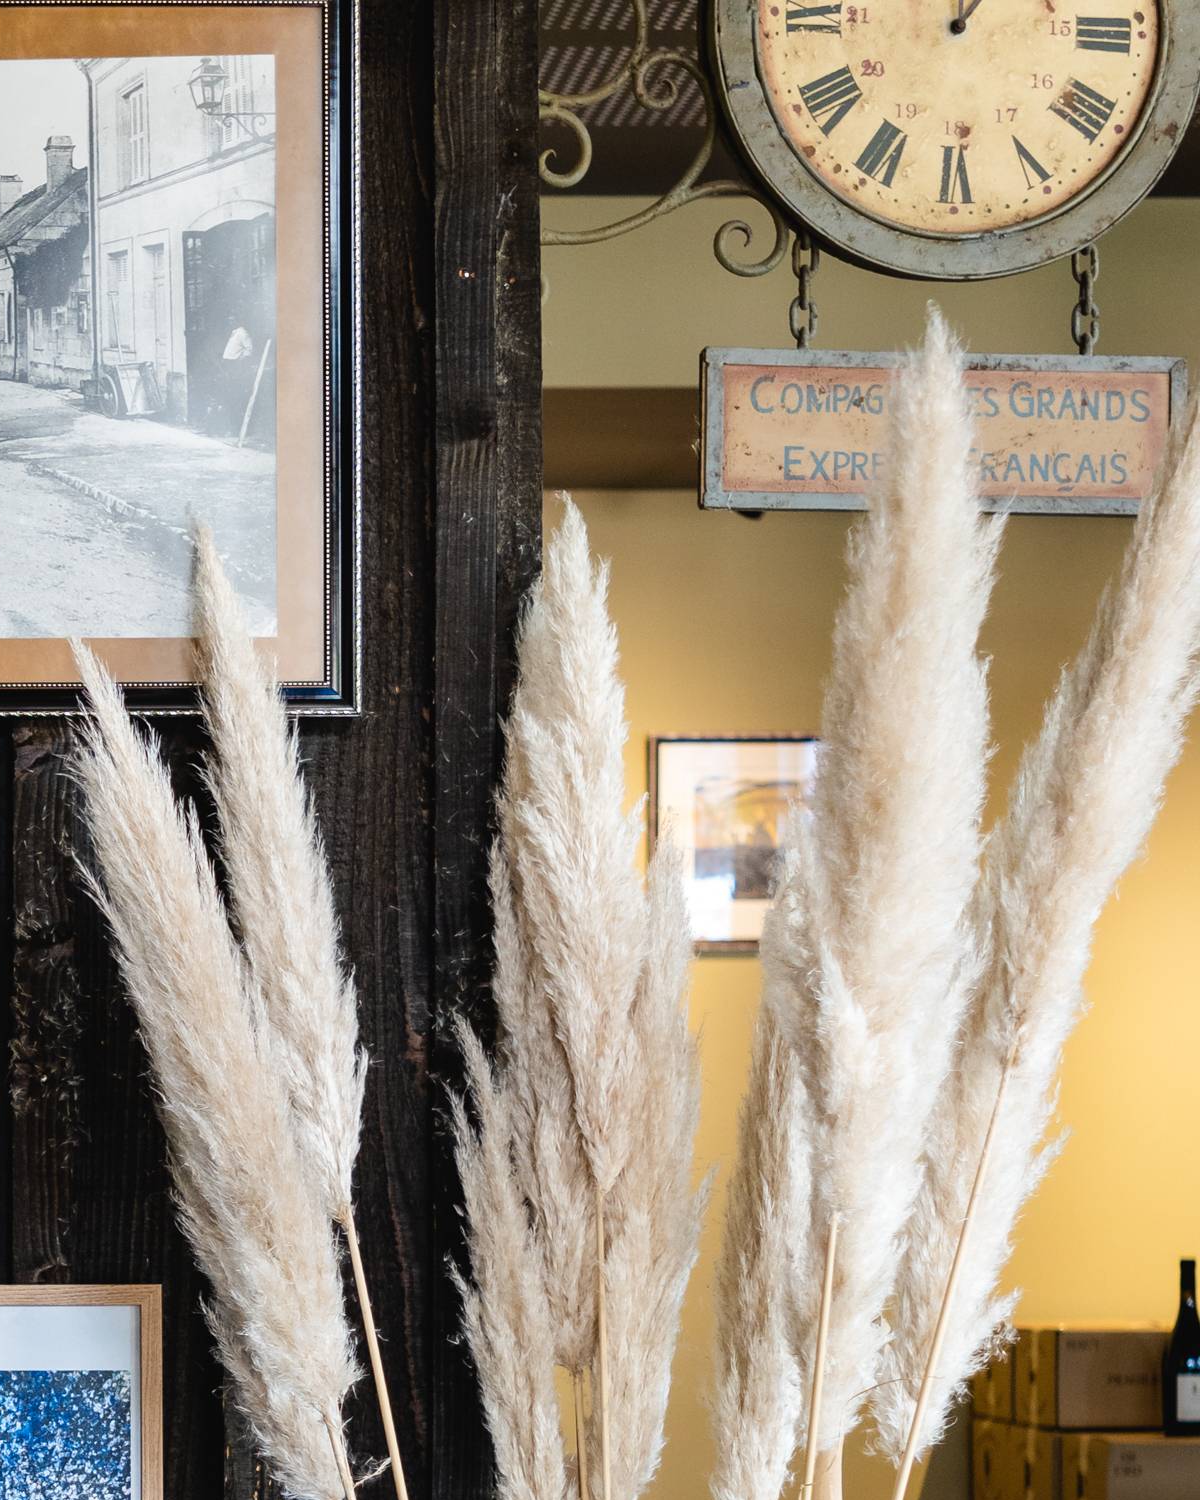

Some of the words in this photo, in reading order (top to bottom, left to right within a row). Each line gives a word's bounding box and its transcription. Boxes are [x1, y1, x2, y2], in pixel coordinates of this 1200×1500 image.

[1049, 20, 1071, 36] 15
[860, 59, 885, 77] 20
[1031, 73, 1053, 89] 16
[895, 102, 918, 119] 19
[995, 107, 1018, 123] 17
[1011, 134, 1054, 190] V
[750, 375, 896, 416] COMPAG
[1008, 380, 1151, 423] GRANDS
